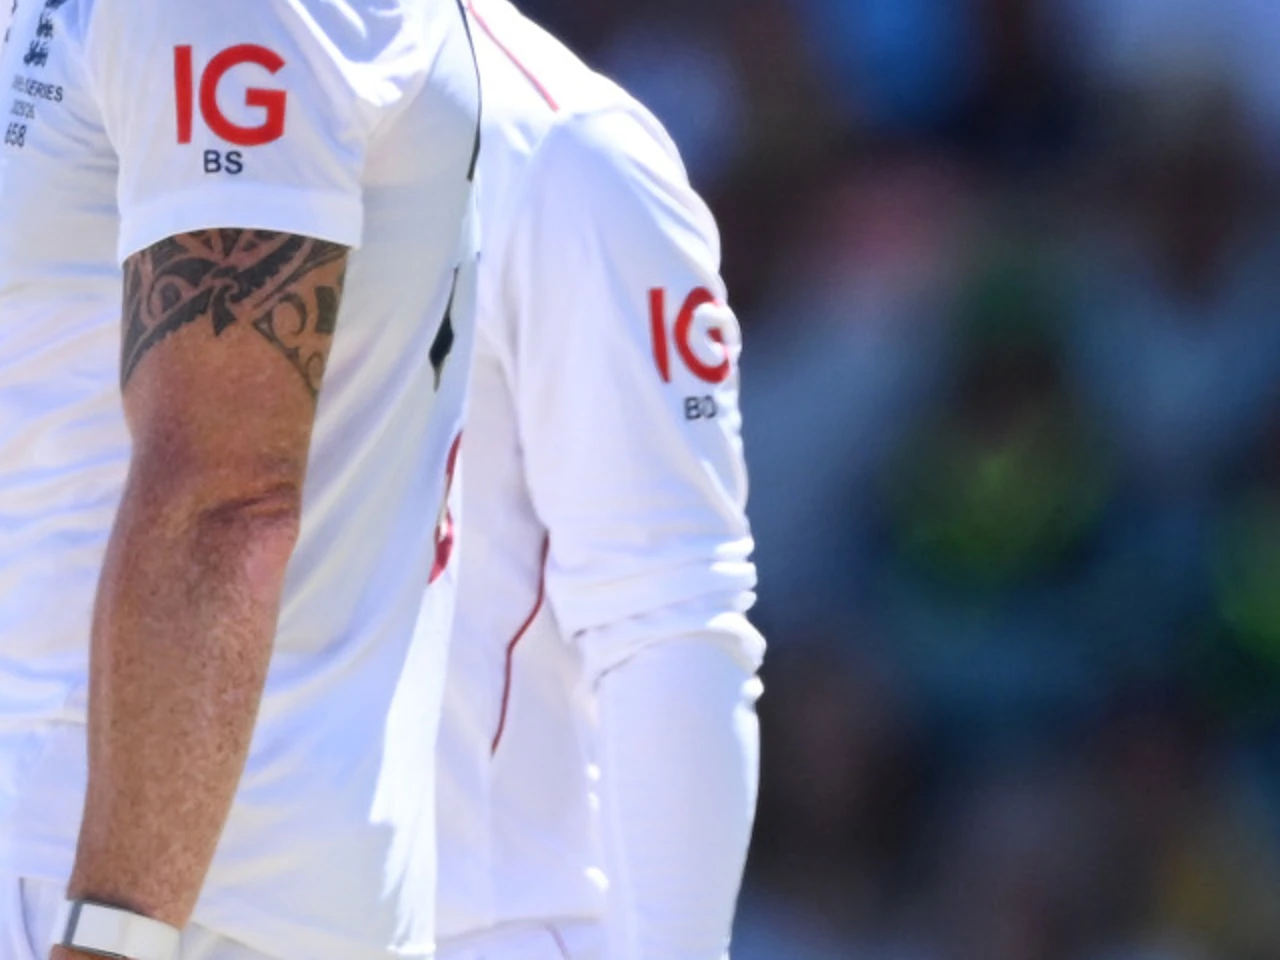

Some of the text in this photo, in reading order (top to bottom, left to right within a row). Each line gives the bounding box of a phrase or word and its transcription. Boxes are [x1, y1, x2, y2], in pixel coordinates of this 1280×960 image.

[173, 42, 287, 147] IG
[203, 149, 243, 175] BS
[647, 286, 731, 385] IG
